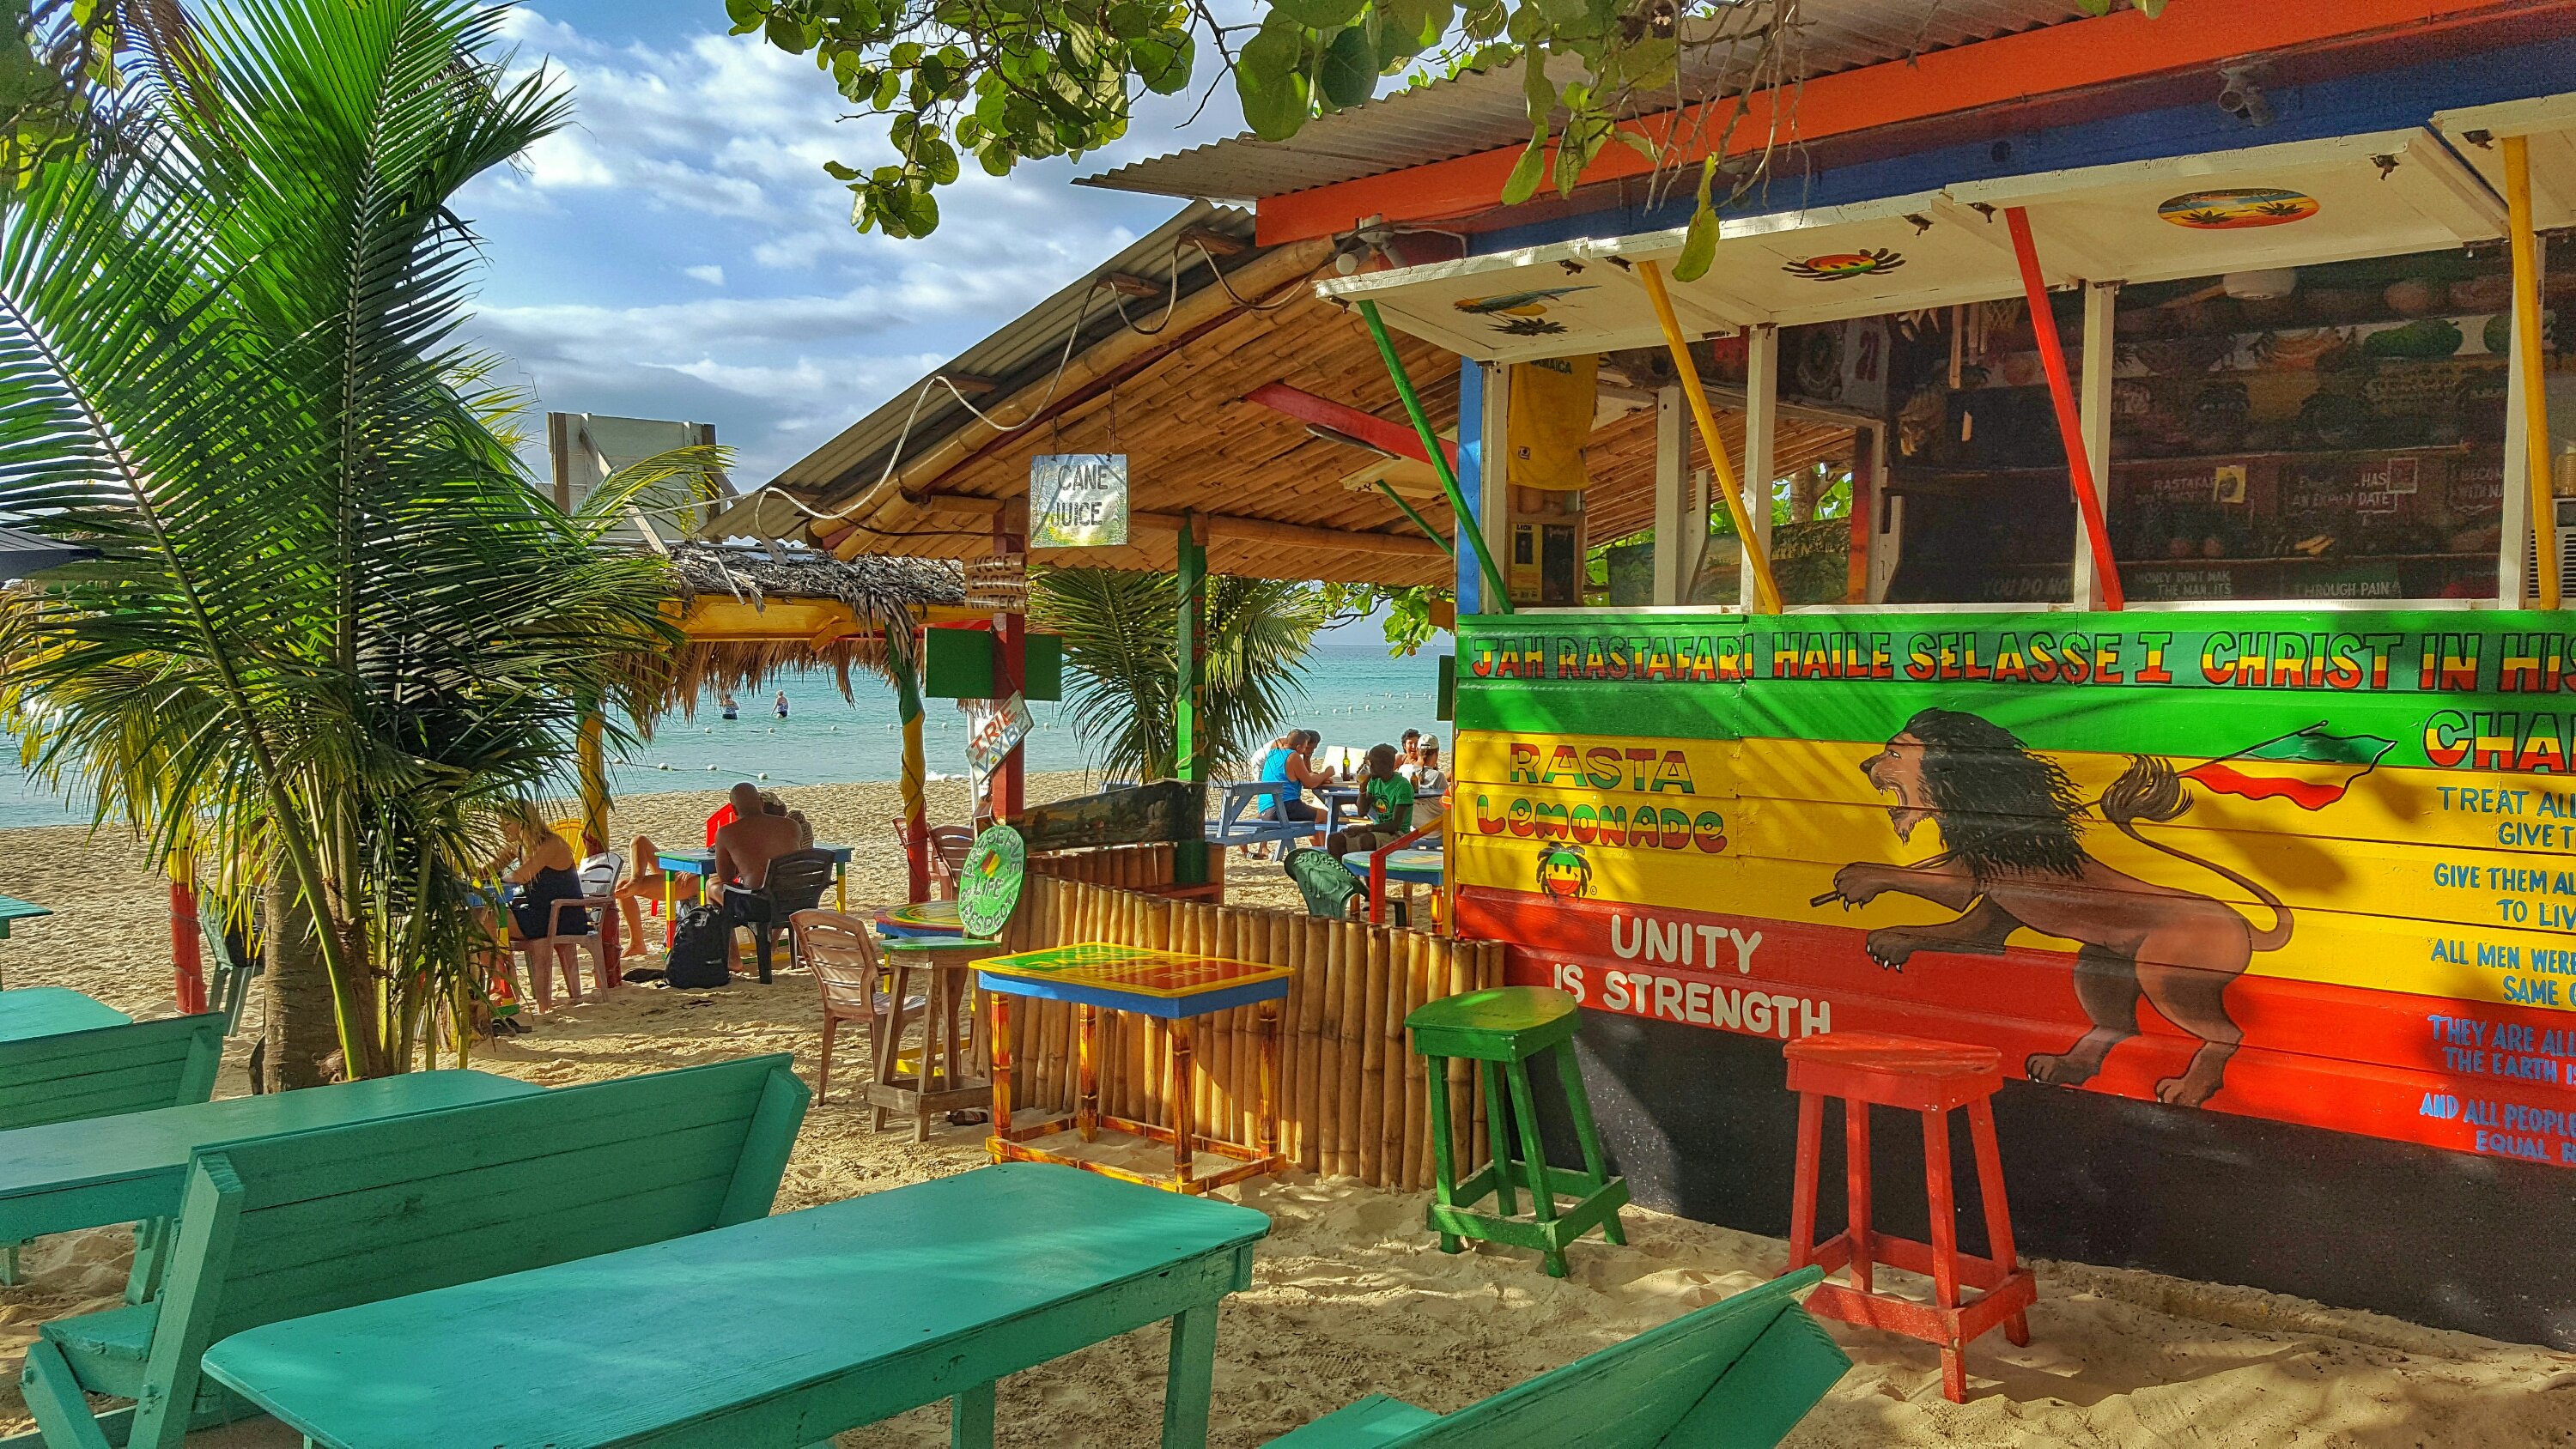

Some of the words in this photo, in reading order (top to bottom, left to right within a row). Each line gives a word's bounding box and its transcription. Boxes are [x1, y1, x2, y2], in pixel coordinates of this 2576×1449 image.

[1058, 464, 1109, 490] CANE
[1051, 501, 1103, 527] JUICE
[2358, 491, 2390, 506] DATE
[971, 574, 1021, 591] EARTH
[2157, 584, 2178, 596] THE
[969, 594, 1018, 609] WATER
[1472, 637, 1546, 680] JAH
[1557, 633, 1755, 682] RASTAFARI
[1771, 632, 1893, 682] HAILE
[1903, 632, 2123, 684] SELASSE
[2136, 631, 2173, 684] I
[2200, 631, 2406, 690] CHRIST
[2418, 632, 2483, 692] IN
[970, 700, 1018, 761] IRIE
[976, 712, 1030, 773] VYBZ
[1510, 742, 1696, 795] RASTA
[2437, 786, 2530, 815] TREAT
[2499, 822, 2555, 847] GIVE
[963, 827, 1023, 879] PRESERVE
[973, 876, 1004, 898] LIFE
[2433, 863, 2481, 888] GIVE
[2487, 867, 2547, 894] THEM
[2496, 899, 2528, 923] TO
[1611, 914, 1764, 974] UNITY
[2431, 938, 2469, 965] ALL
[2477, 942, 2520, 969] MEN
[1554, 963, 1585, 1003] IS
[1603, 971, 1832, 1040] STRENGTH
[2503, 975, 2559, 1006] SAME
[2427, 1015, 2487, 1046] THEY
[2492, 1022, 2534, 1052] ARE
[2443, 1047, 2486, 1073] THE
[2493, 1052, 2558, 1083] EARTH
[2420, 1092, 2459, 1119] AND
[2464, 1099, 2500, 1127] ALL
[2505, 1103, 2576, 1139] PEOPLE
[2476, 1130, 2550, 1160] EQUAL
